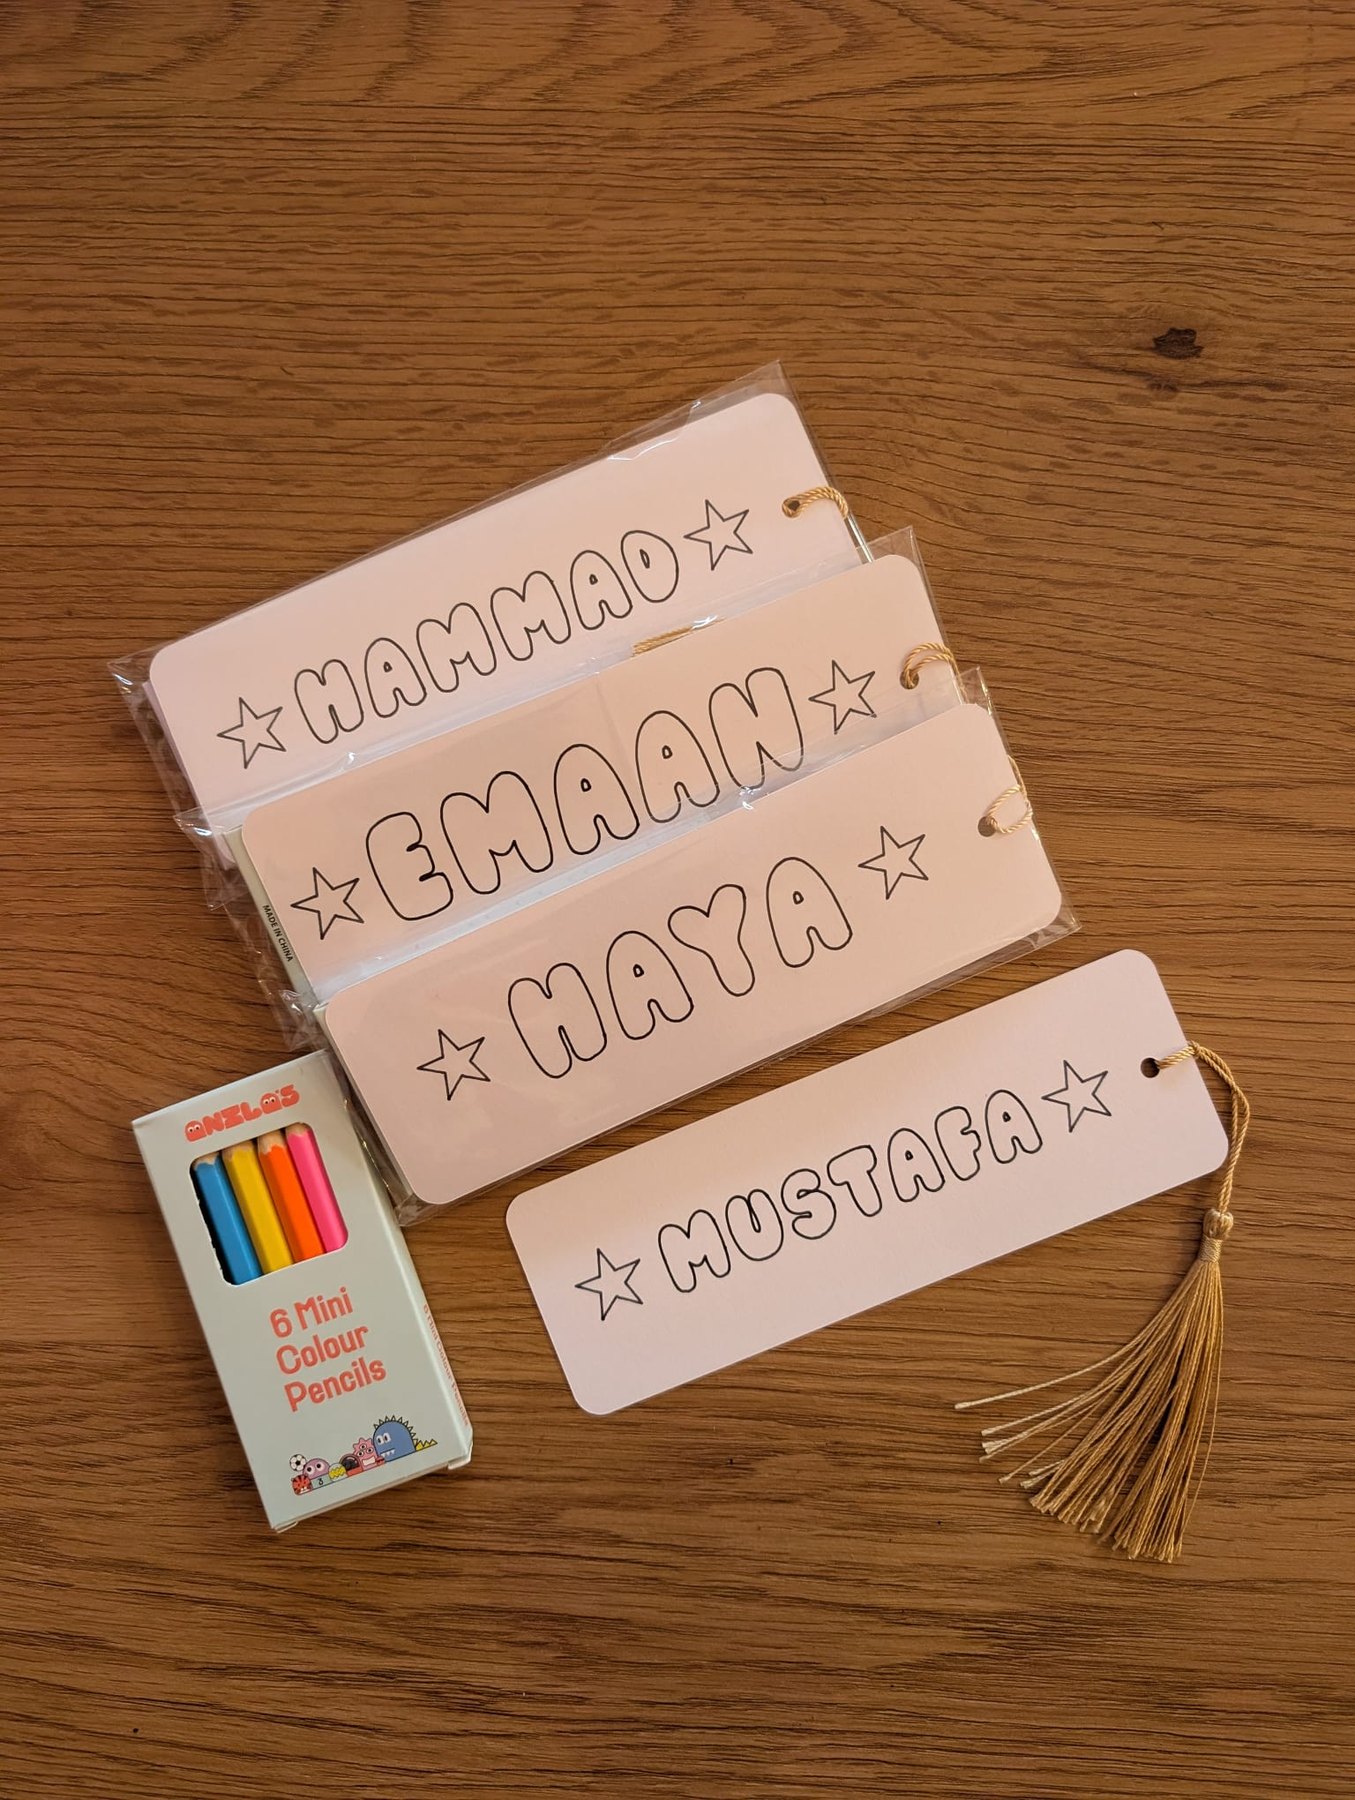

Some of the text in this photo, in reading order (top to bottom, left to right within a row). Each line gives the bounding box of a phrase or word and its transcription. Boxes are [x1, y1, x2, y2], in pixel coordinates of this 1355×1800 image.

[294, 530, 680, 744] HAMMAD
[365, 667, 804, 921] EMAAN
[263, 905, 294, 962] MADE IN CHINA
[507, 857, 853, 1079] HAYA
[657, 1090, 1043, 1293] MUSTAFA
[269, 1286, 354, 1338] 6 Mini
[276, 1325, 370, 1375] Colour
[284, 1356, 387, 1413] Pencils
